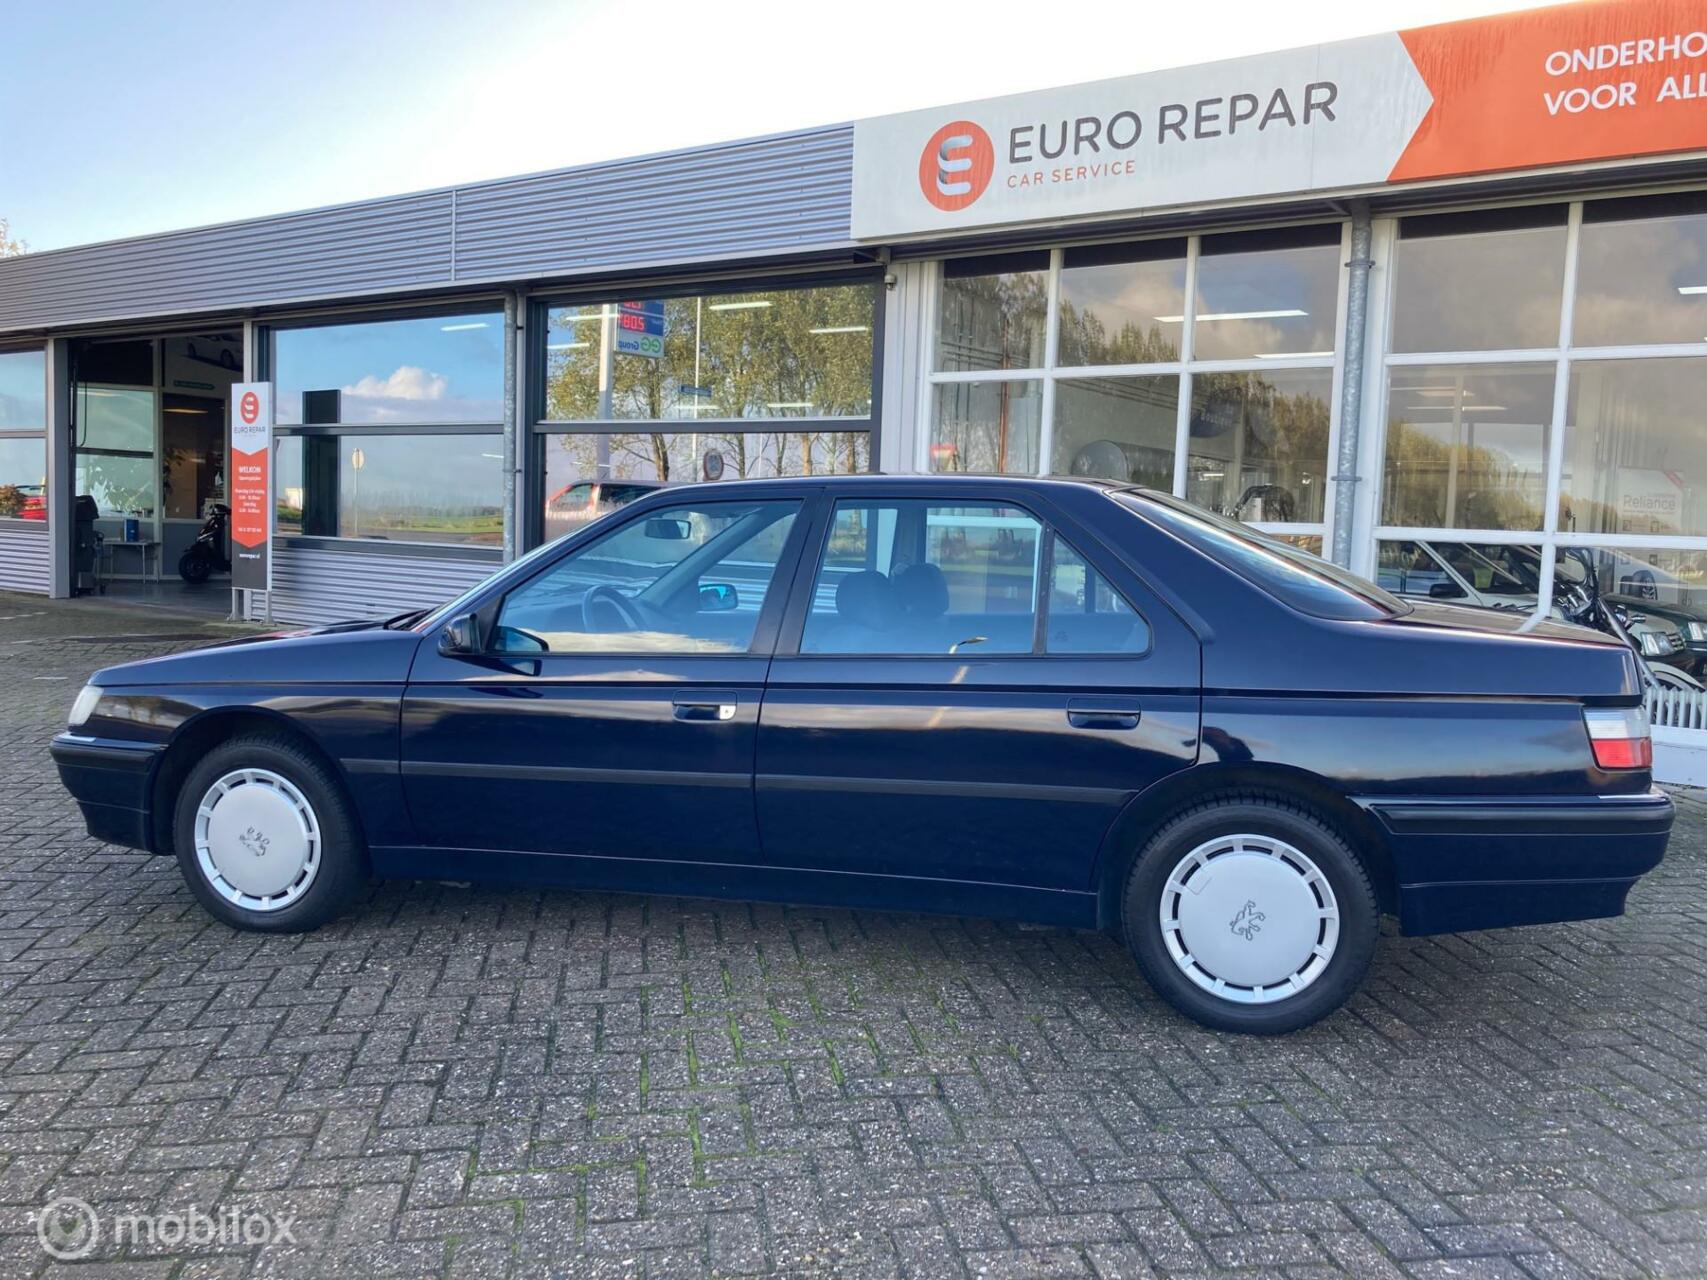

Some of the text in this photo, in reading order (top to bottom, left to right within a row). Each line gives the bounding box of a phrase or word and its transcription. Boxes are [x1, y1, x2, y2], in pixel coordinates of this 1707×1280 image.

[1545, 31, 1707, 76] ONDERHO
[1543, 72, 1707, 116] VOOR ALL
[1008, 80, 1338, 164] EURO REPAR
[1007, 160, 1137, 189] CAR SERVICE
[1623, 494, 1676, 510] Reliance
